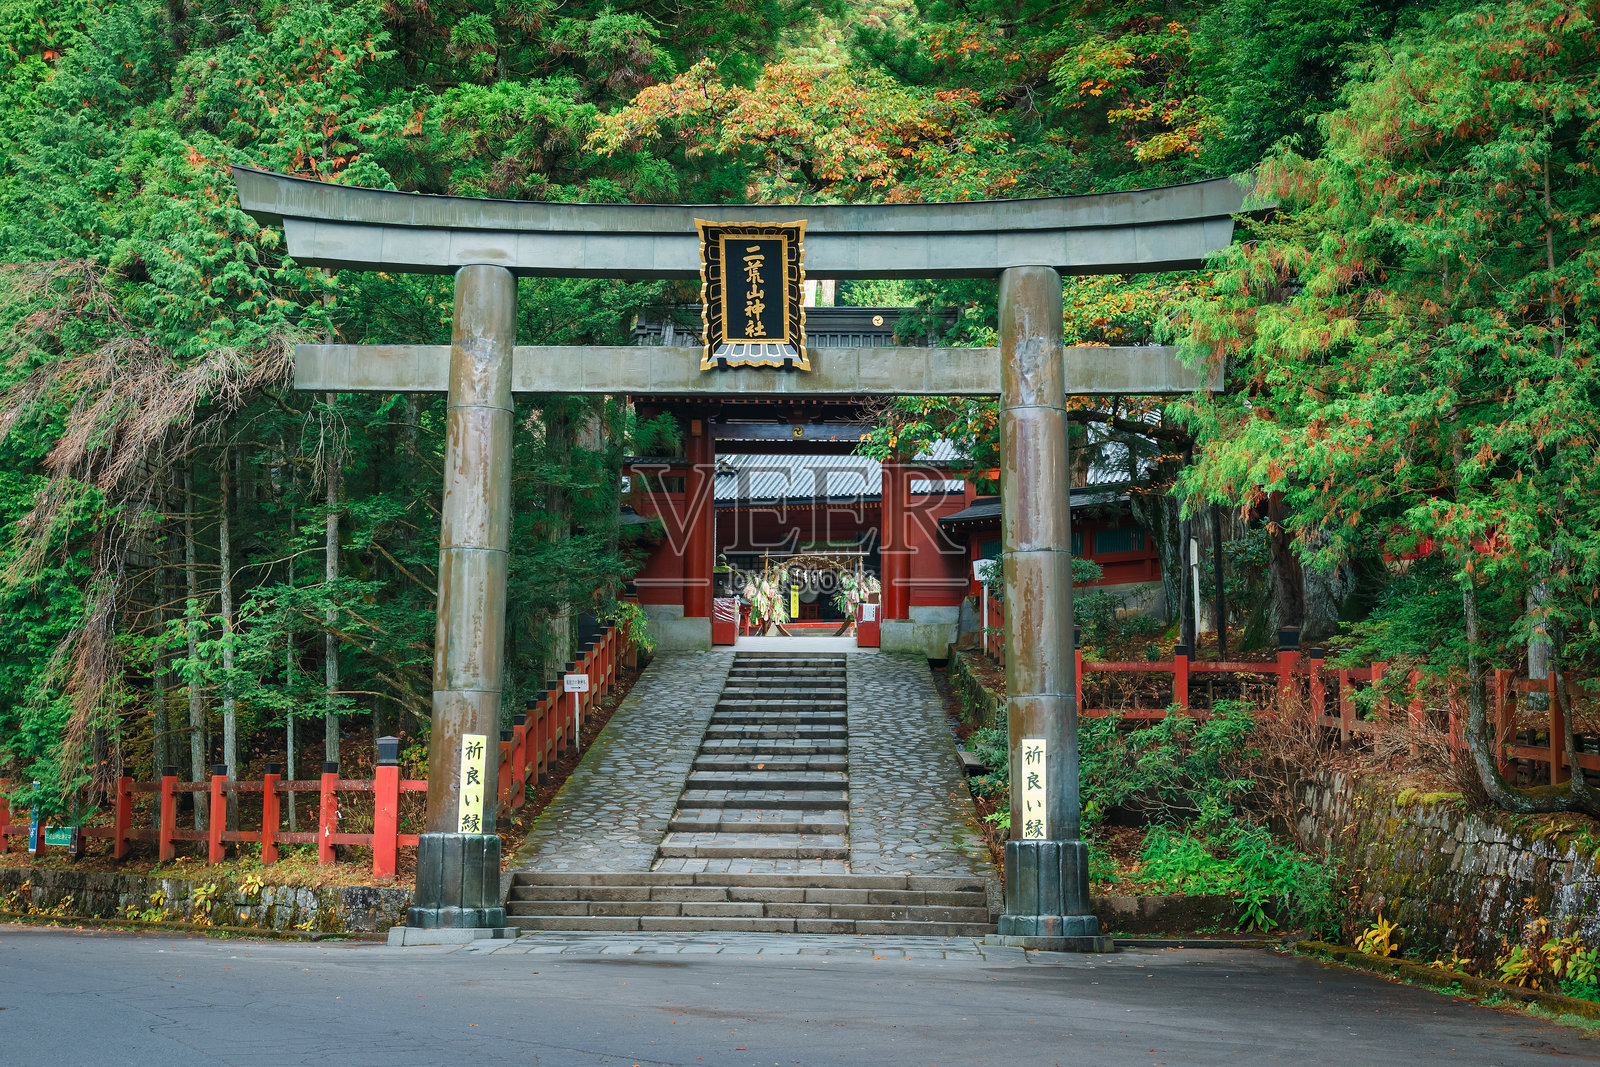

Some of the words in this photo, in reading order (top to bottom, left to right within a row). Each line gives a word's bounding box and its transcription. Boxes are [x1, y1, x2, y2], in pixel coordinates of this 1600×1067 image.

[742, 245, 767, 338] 二荒山神社
[461, 741, 484, 833] 祈良い縁
[1024, 745, 1044, 839] 祈良い縁
